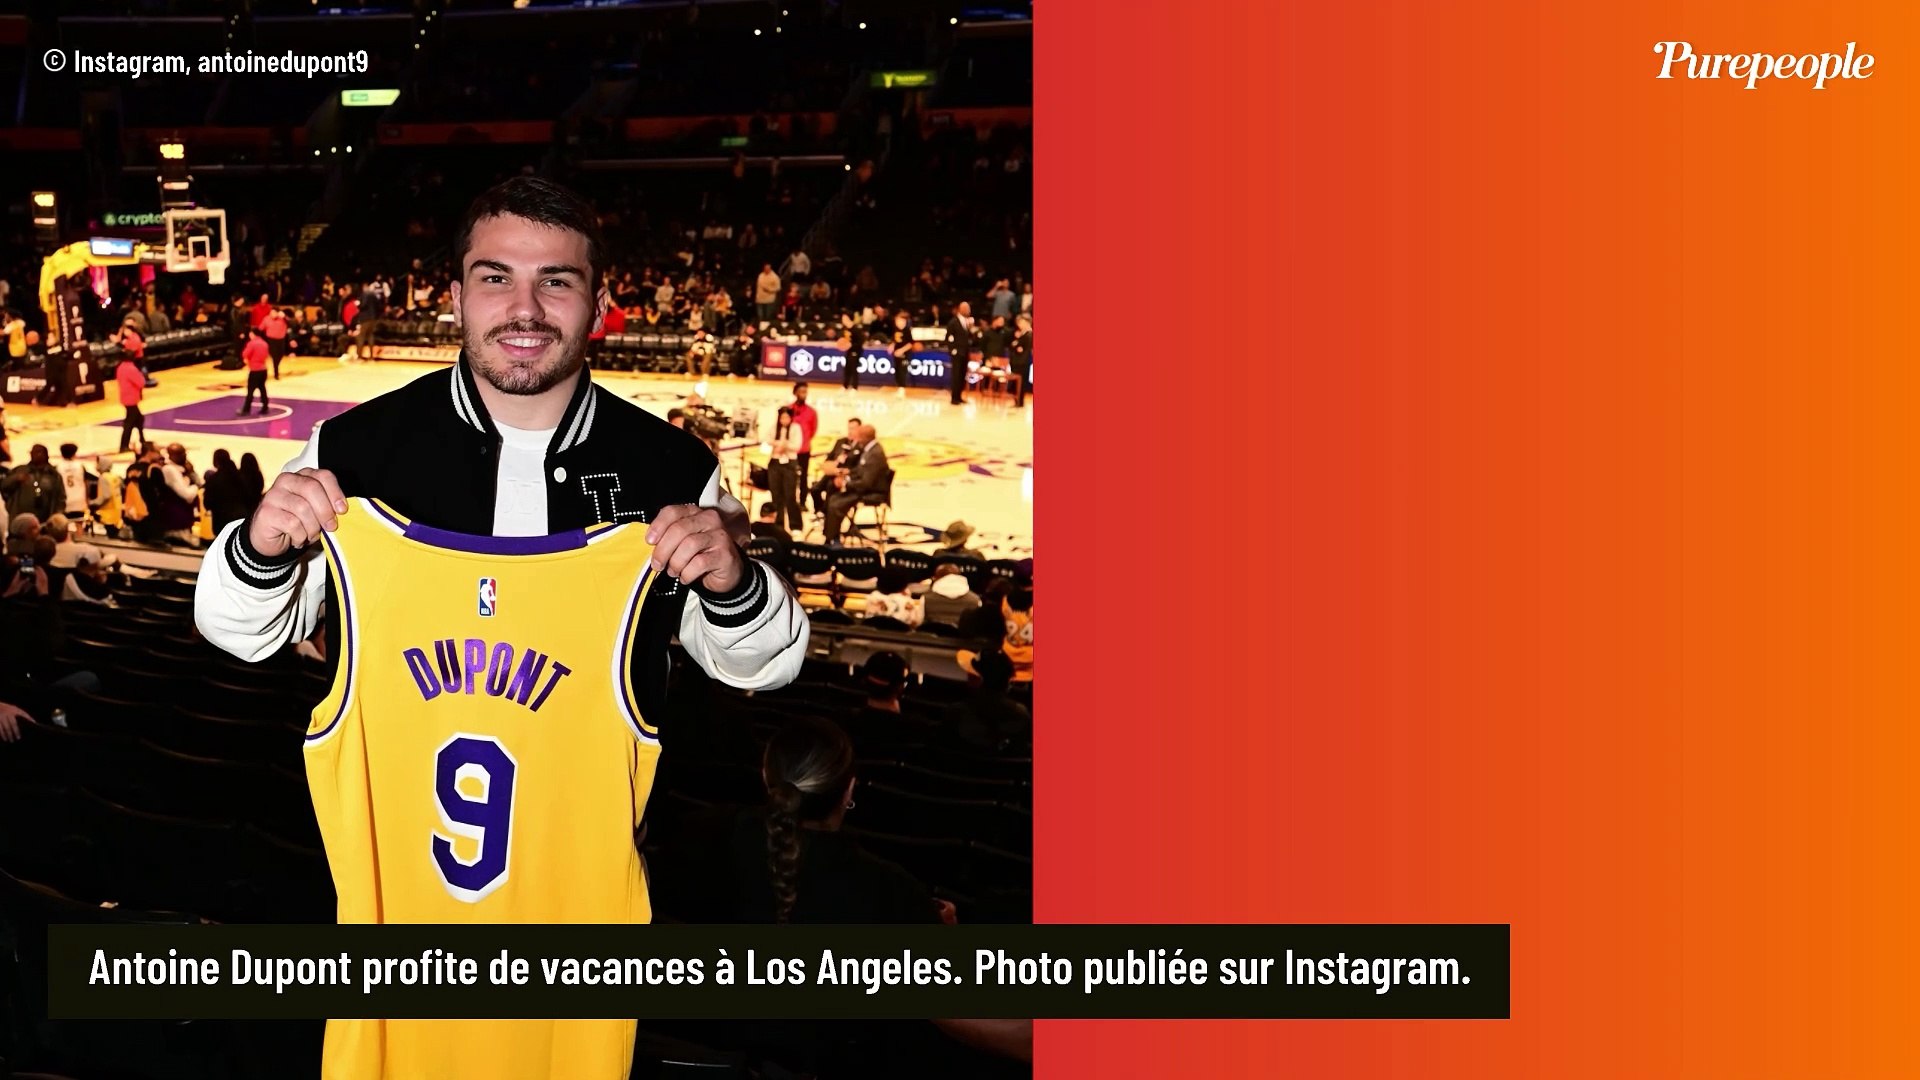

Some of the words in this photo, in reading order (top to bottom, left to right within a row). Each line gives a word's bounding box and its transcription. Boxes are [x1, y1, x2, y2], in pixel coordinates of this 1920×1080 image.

[817, 353, 945, 377] crpto.om
[403, 638, 572, 713] DUPONT
[429, 732, 518, 904] 9
